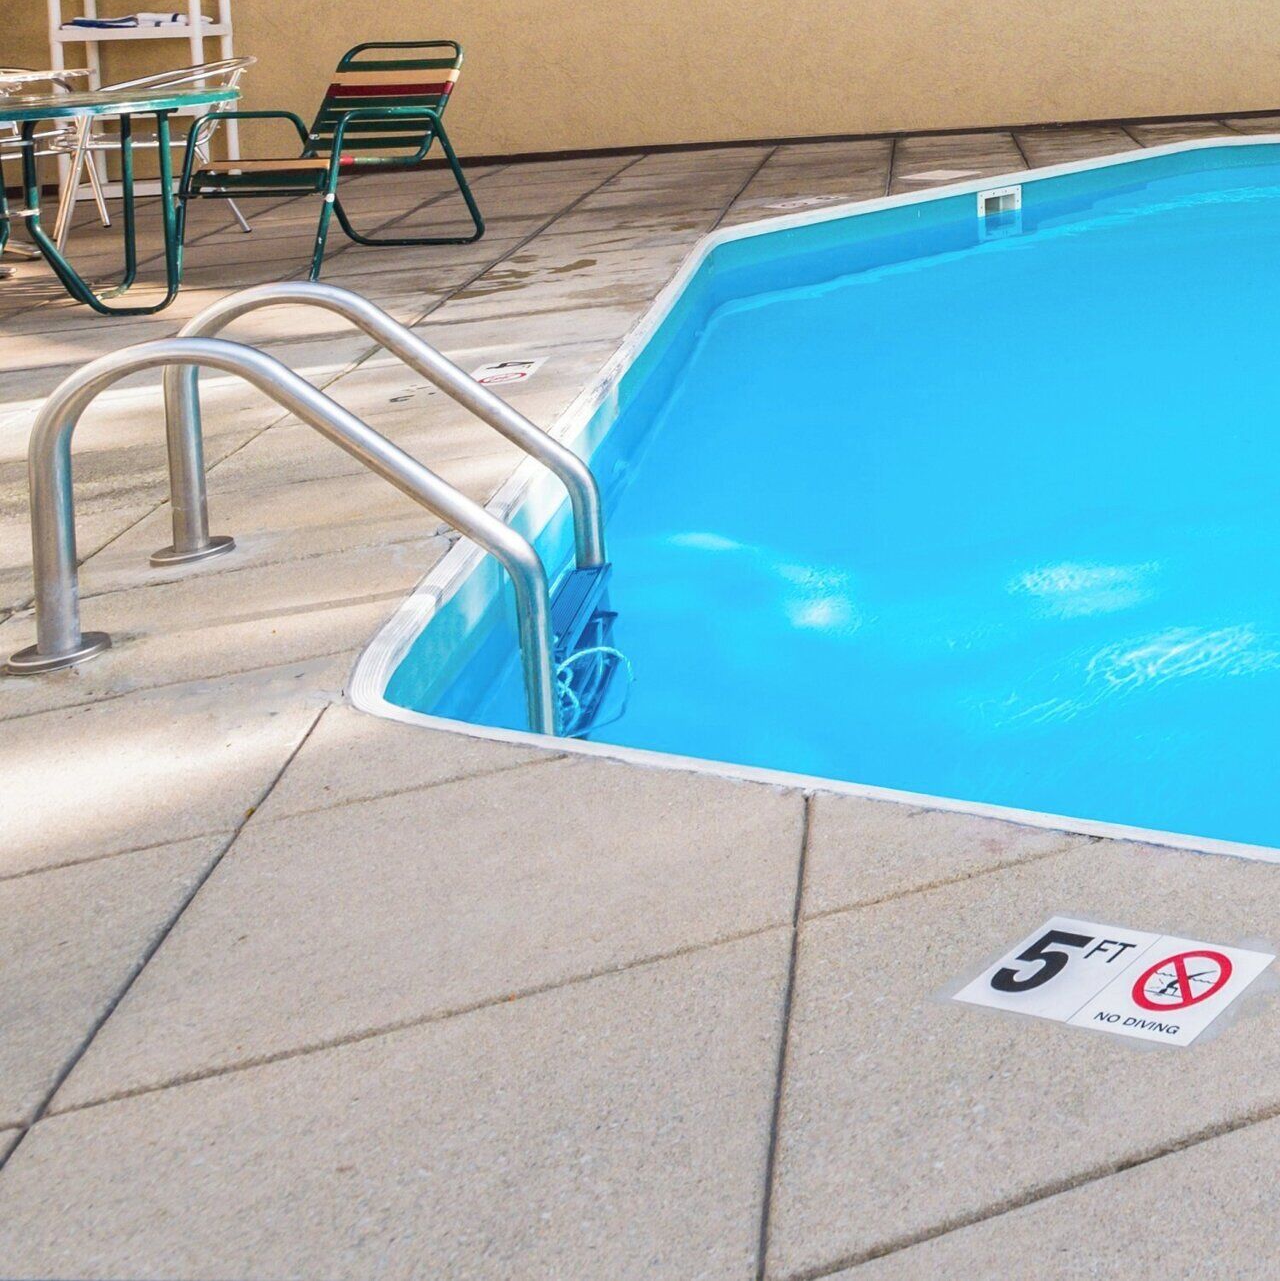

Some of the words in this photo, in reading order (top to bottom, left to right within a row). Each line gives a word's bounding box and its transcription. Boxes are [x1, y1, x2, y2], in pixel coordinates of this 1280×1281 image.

[990, 928, 1095, 994] 5
[1083, 938, 1137, 964] FT
[1093, 1010, 1121, 1024] NO
[1122, 1015, 1181, 1035] DIVING
